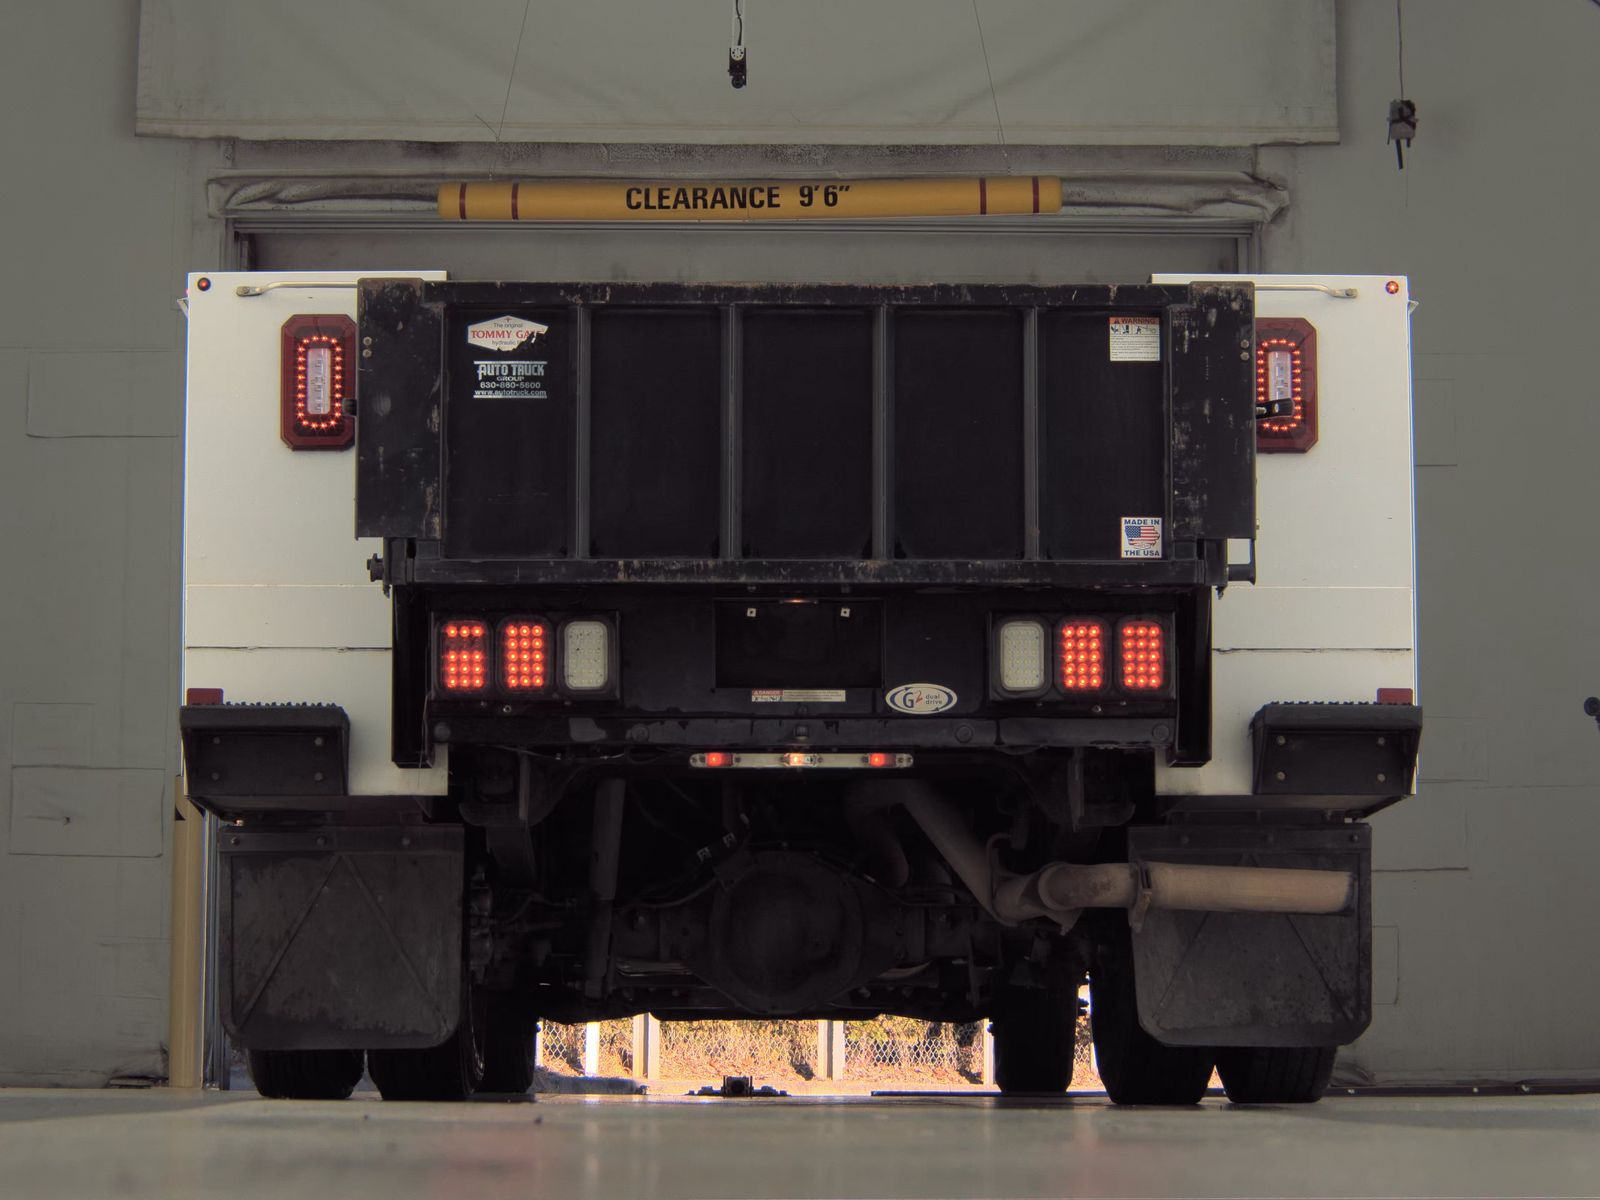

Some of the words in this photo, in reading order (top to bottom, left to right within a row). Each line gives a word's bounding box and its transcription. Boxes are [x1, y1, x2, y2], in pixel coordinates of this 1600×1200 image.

[626, 186, 780, 210] CLEARANCE
[504, 322, 523, 330] original
[471, 330, 512, 339] TOMMY
[516, 330, 543, 339] GA
[477, 364, 509, 380] AUTO
[511, 364, 545, 375] TRUCK
